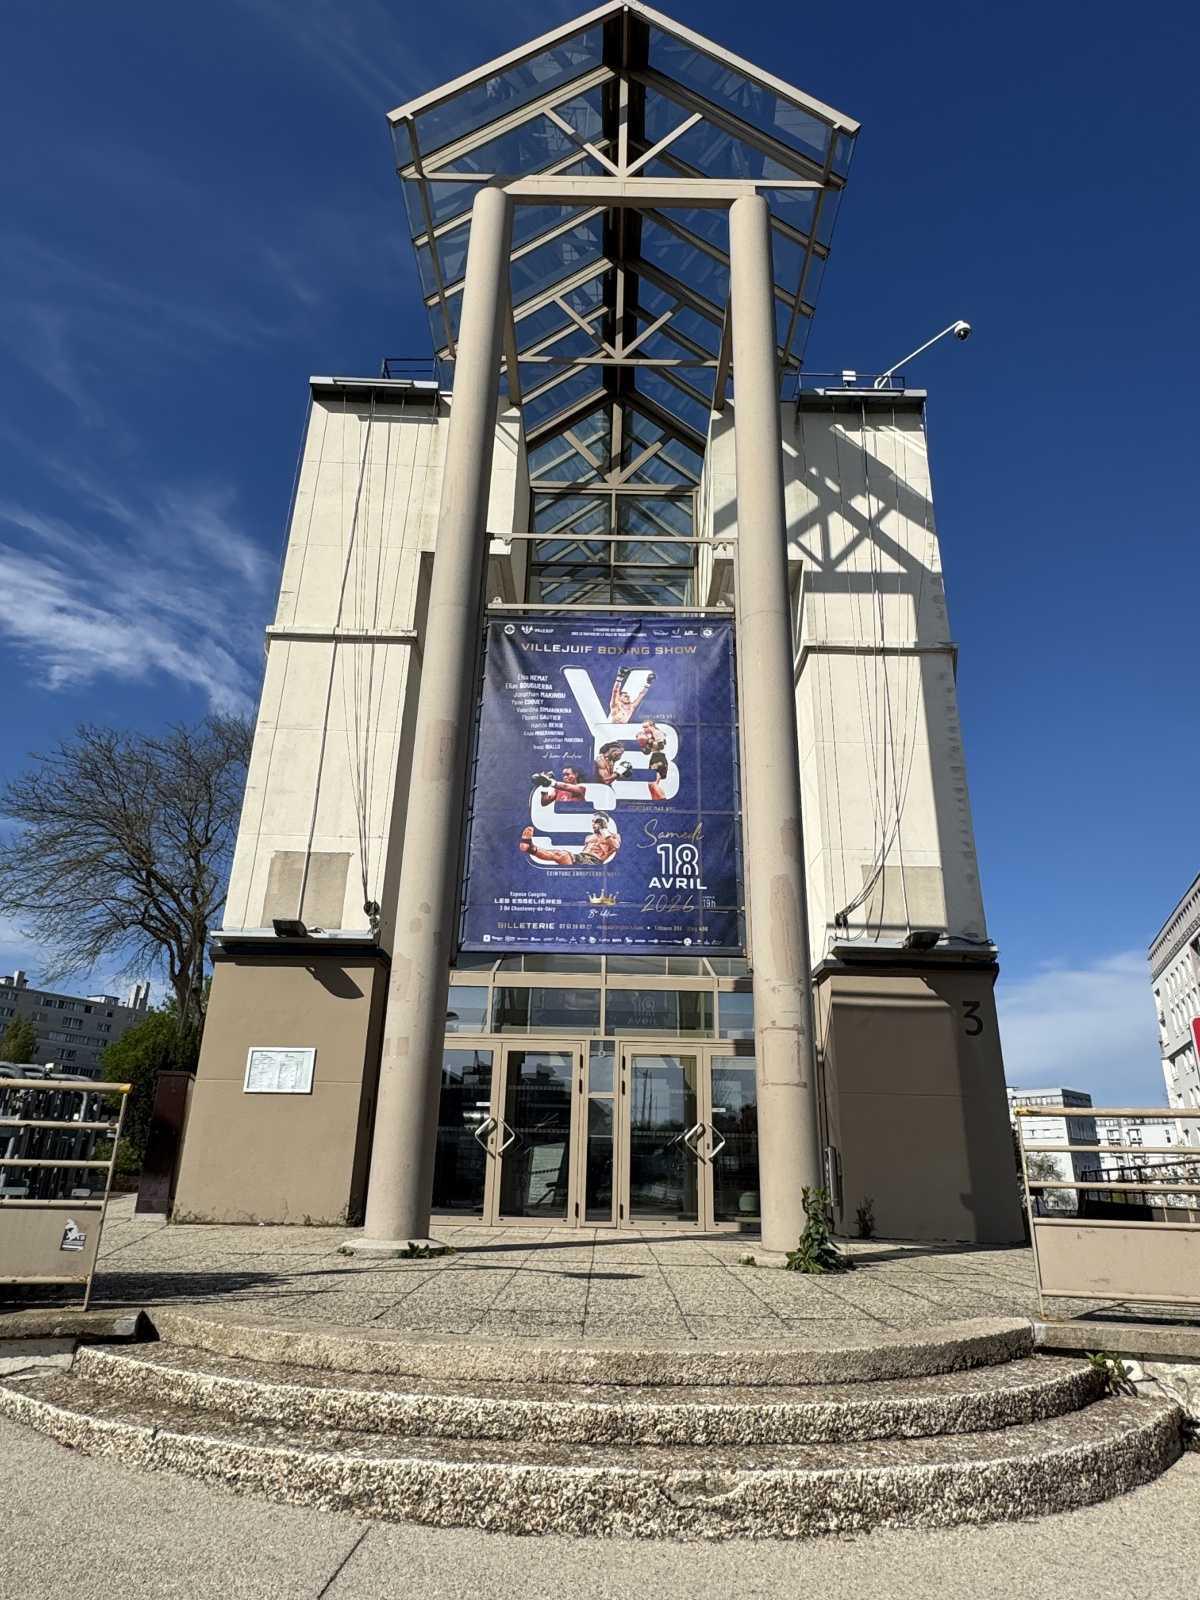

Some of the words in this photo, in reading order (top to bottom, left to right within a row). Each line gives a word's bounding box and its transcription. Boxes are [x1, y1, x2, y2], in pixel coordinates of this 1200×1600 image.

[521, 643, 593, 654] VILLEJUIF
[598, 646, 650, 655] BOXING
[655, 646, 697, 655] SHOW
[636, 818, 705, 849] Samedi
[656, 843, 699, 876] 18
[648, 877, 708, 890] AVRIL
[640, 894, 696, 912] 2026
[497, 921, 556, 930] BILLETERIE
[962, 1000, 984, 1037] 3
